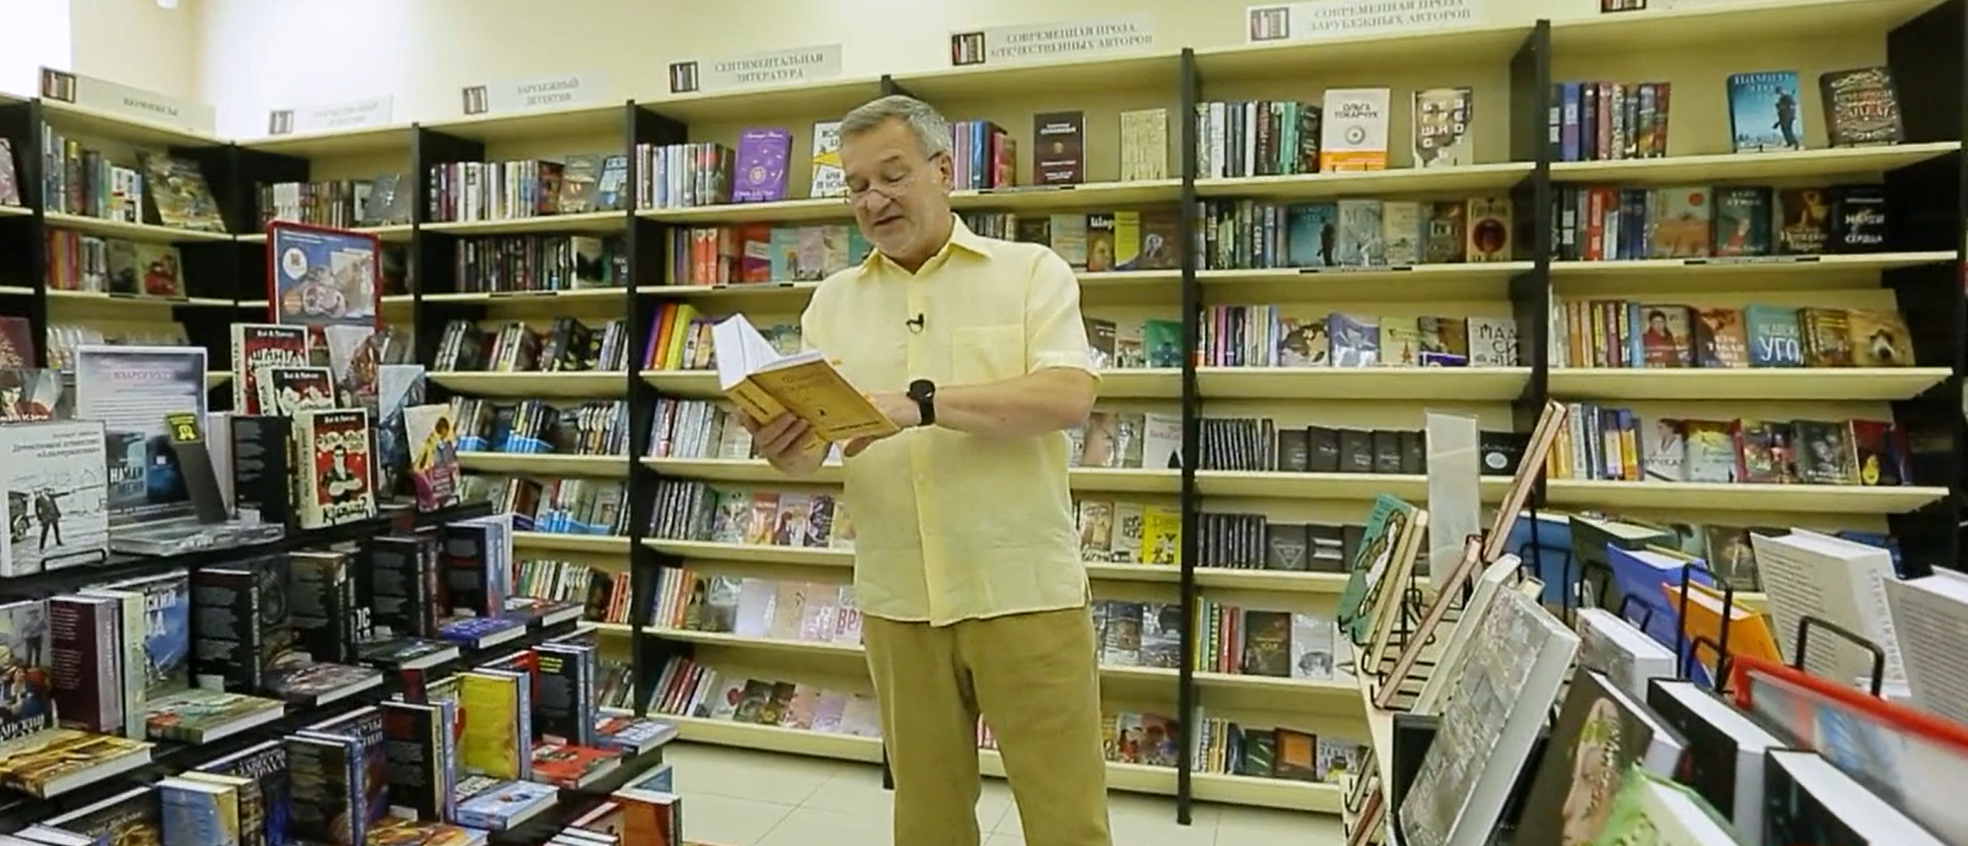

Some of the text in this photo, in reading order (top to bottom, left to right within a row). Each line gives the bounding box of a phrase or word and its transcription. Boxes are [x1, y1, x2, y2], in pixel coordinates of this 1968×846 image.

[1314, 1, 1414, 18] СОВРЕМЕННАЯ
[1310, 9, 1471, 31] ЗАРУБЕЖНЫХ АВТОРОВ
[1006, 22, 1136, 44] СОВРЕМЕННАЯ ПРОЗА
[1098, 35, 1153, 48] АВТОРОВ
[714, 53, 823, 73] СЕНТИМЕНТАЛЬНАЯ
[736, 68, 804, 83] ЛИТЕРАТУРА
[1334, 110, 1379, 119] ТОКАРЧУК
[1342, 103, 1371, 111] ОЛЬГА
